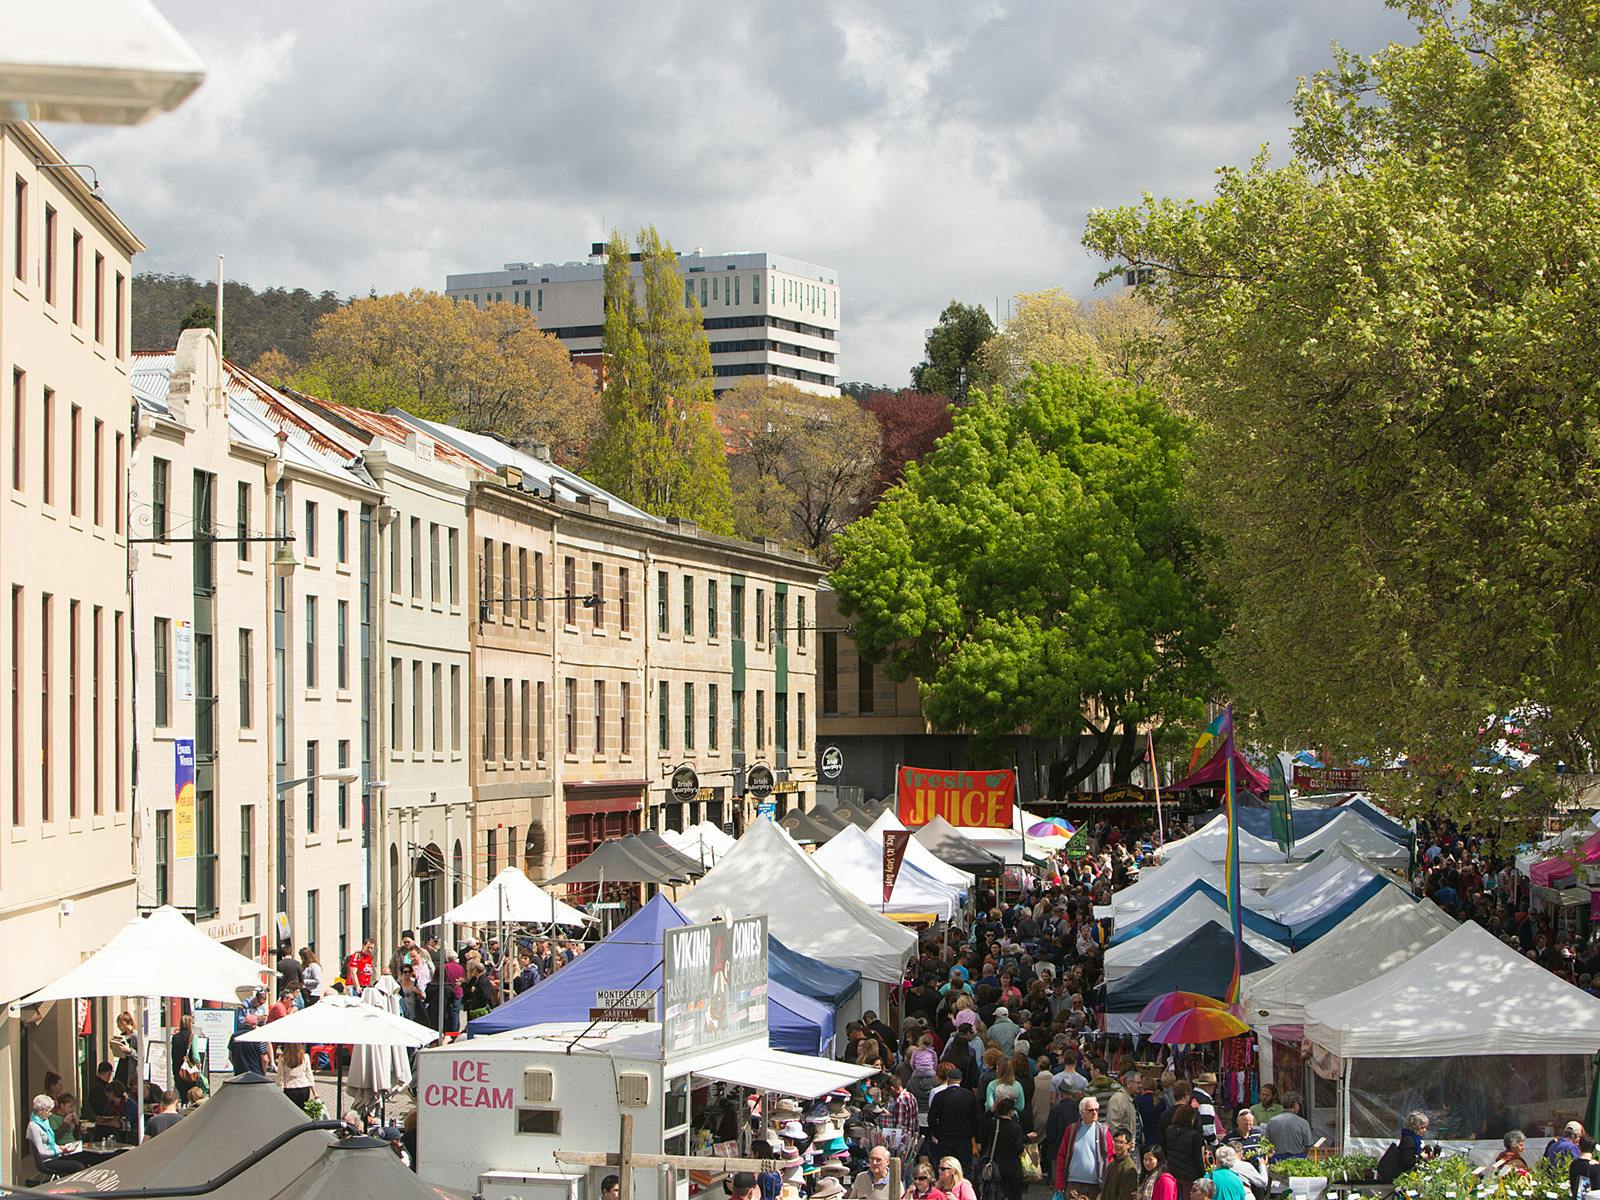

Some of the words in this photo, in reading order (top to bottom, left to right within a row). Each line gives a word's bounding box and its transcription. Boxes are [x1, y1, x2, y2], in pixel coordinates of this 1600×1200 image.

[904, 768, 974, 789] fresh
[909, 789, 1007, 827] JUICE
[672, 927, 711, 970] VIKING
[732, 919, 762, 960] CONES
[597, 990, 646, 999] MONTPELIER
[605, 999, 639, 1007] RETREAT
[452, 1059, 491, 1083] ICE
[424, 1083, 514, 1110] CREAM
